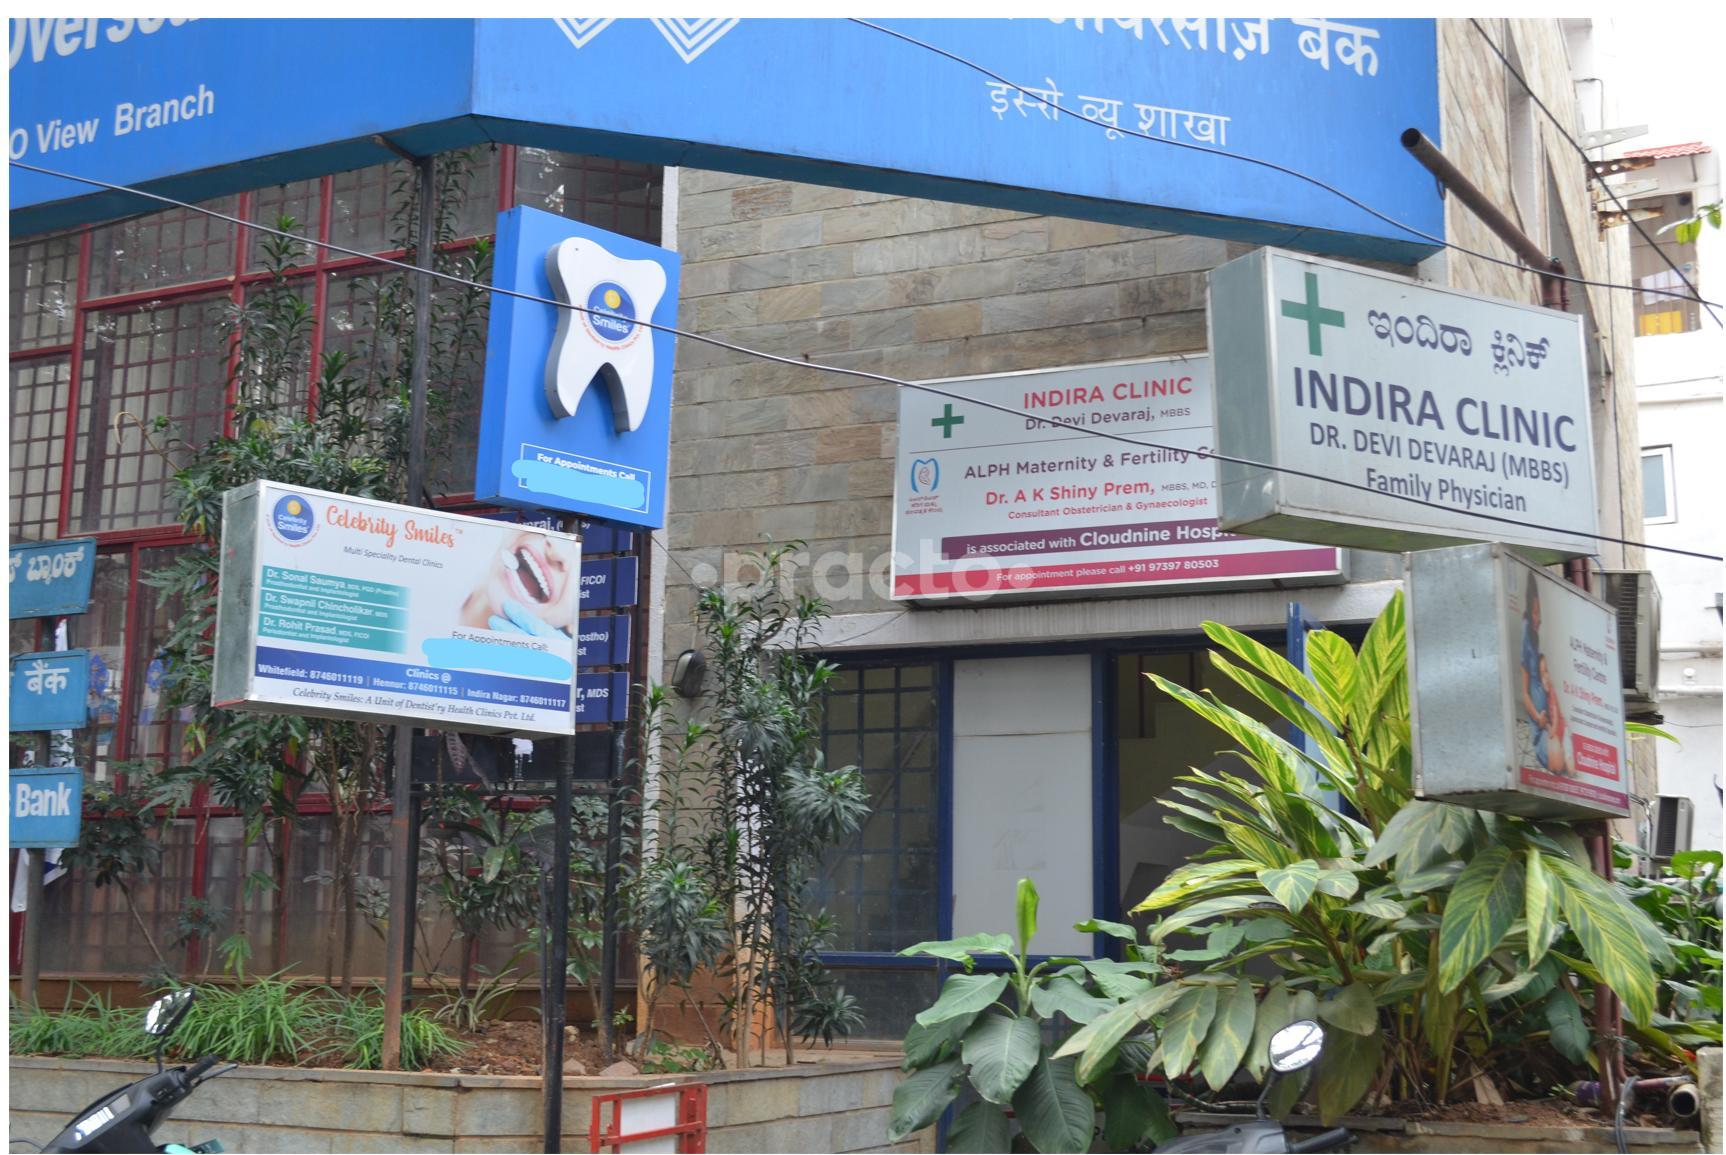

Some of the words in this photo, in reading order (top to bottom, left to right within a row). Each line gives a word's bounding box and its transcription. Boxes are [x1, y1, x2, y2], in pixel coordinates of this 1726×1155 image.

[36, 117, 99, 153] View
[114, 84, 215, 136] Branch
[1134, 102, 1231, 146] शाखा
[593, 314, 629, 334] Smiles
[1024, 385, 1104, 409] INDIRA
[1113, 376, 1193, 401] CLINIC
[1026, 417, 1046, 431] Dr.
[1091, 407, 1155, 424] Devaraj,
[1160, 407, 1191, 418] MBBS
[1293, 366, 1445, 431] INDIRA
[1456, 397, 1577, 453] CLINIC
[537, 453, 553, 464] For
[964, 463, 1010, 479] ALPH
[1016, 454, 1097, 475] Maternity
[1103, 453, 1115, 468] &
[1121, 448, 1190, 466] Fertility
[1309, 422, 1346, 450] DR.
[1354, 429, 1401, 458] DEVI
[1409, 437, 1496, 473] DEVARAJ
[1501, 451, 1570, 489] (MBBS)
[986, 491, 1008, 505] Dr.
[1014, 489, 1027, 503] A
[1033, 488, 1045, 501] K
[1050, 483, 1098, 500] Shiny
[1104, 481, 1155, 496] Prem,
[1366, 468, 1433, 502] Family
[1438, 478, 1527, 512] Physician
[1008, 508, 1060, 520] Consultant
[1063, 502, 1123, 516] Obstetrician
[1126, 503, 1133, 511] &
[1136, 497, 1208, 513] Gynaecologist
[326, 505, 399, 548] Celebrity
[404, 519, 455, 548] Smiles
[967, 543, 977, 554] is
[979, 537, 1046, 554] associated
[1049, 536, 1077, 549] with
[1079, 527, 1171, 547] Cloudnine
[996, 572, 1012, 582] For
[1014, 569, 1074, 583] appointment
[1076, 567, 1107, 579] please
[1109, 565, 1126, 574] call
[1128, 563, 1147, 573] +91
[1149, 561, 1181, 572] 97397
[1183, 559, 1219, 570] 80503
[467, 633, 529, 649] Appointments
[24, 660, 70, 695] बैंक
[257, 664, 308, 678] Whitefield:
[405, 668, 440, 680] Clinics
[441, 672, 452, 684] @
[292, 687, 332, 702] Celebrity
[447, 705, 474, 716] Health
[475, 707, 502, 718] Clinics
[15, 782, 72, 818] Bank
